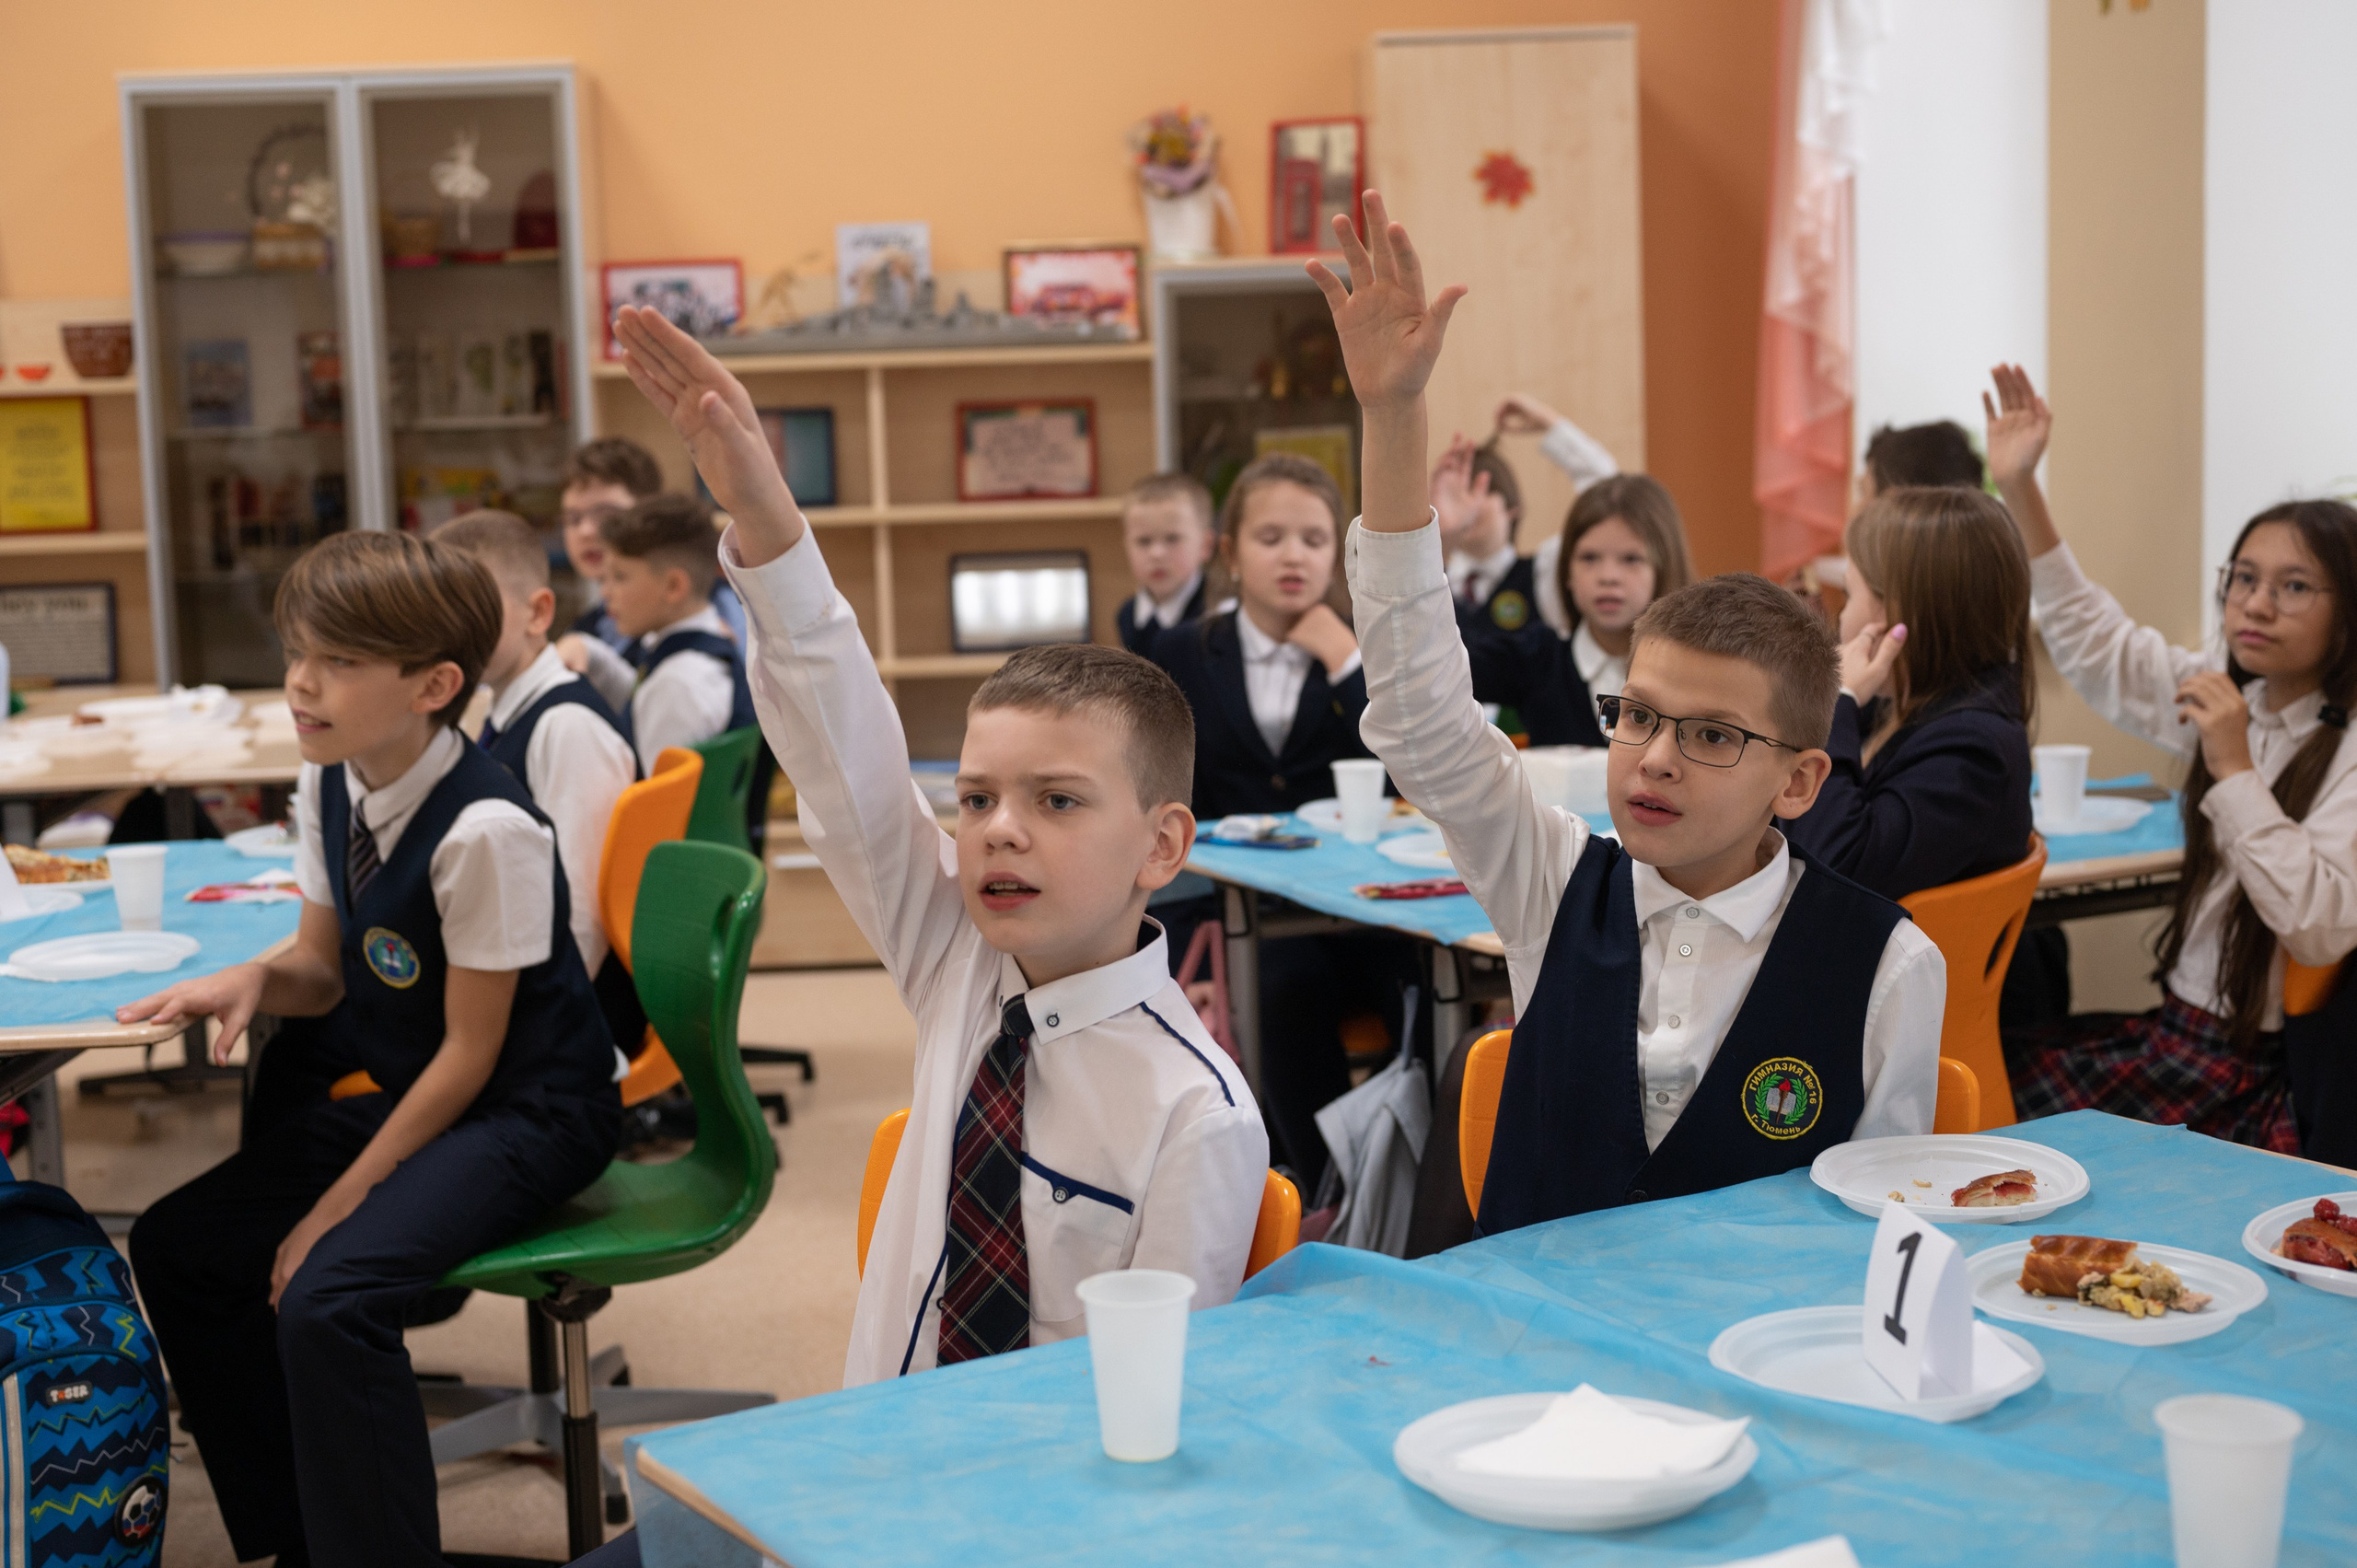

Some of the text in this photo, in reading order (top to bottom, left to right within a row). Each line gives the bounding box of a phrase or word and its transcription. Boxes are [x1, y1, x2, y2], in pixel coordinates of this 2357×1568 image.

[1748, 1062, 1804, 1092] ГИМНАЗИЯ
[1761, 1120, 1801, 1134] Тюмень
[1884, 1231, 1923, 1347] 1
